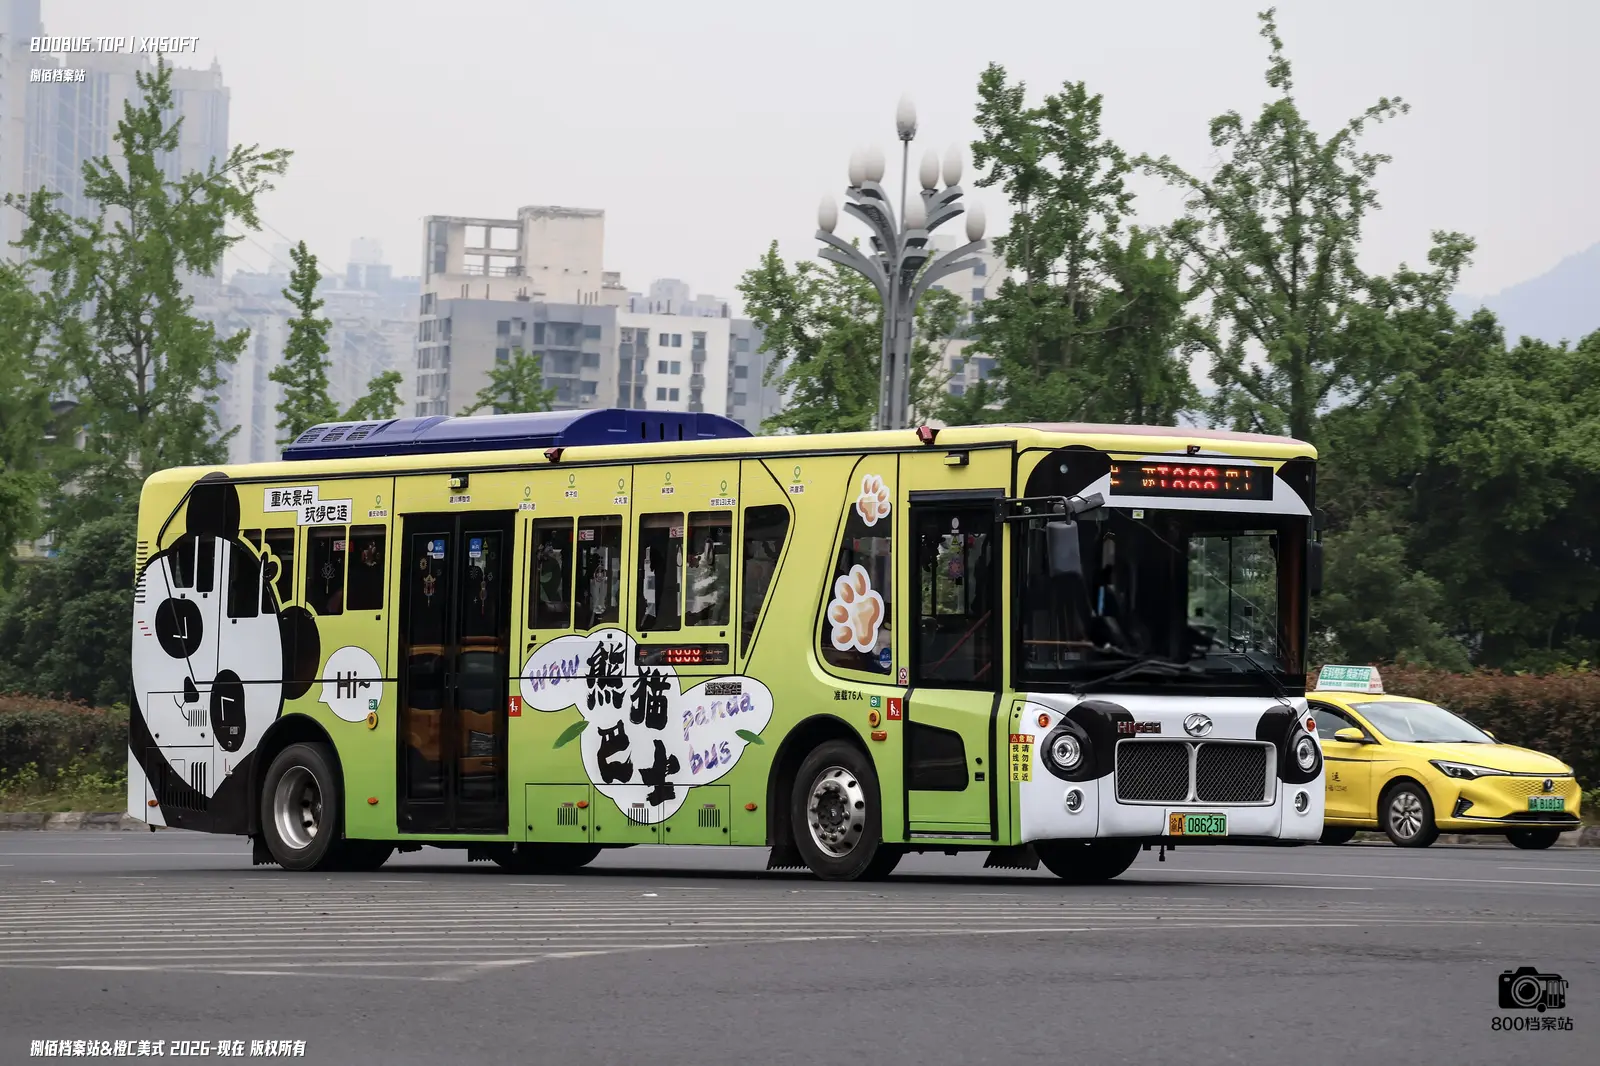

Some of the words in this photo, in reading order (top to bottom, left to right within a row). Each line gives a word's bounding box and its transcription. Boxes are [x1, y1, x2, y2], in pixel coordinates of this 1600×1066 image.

[271, 490, 313, 507] 重庆景点
[305, 505, 347, 523] 玩得巴适
[584, 640, 672, 731] 熊猫
[833, 690, 864, 701] 准载76人
[682, 692, 754, 742] panda
[1117, 721, 1162, 734] HIGER
[1019, 734, 1034, 743] 危险
[596, 719, 681, 807] 巴士
[688, 740, 732, 775] bus
[1021, 744, 1030, 782] 请勿靠近
